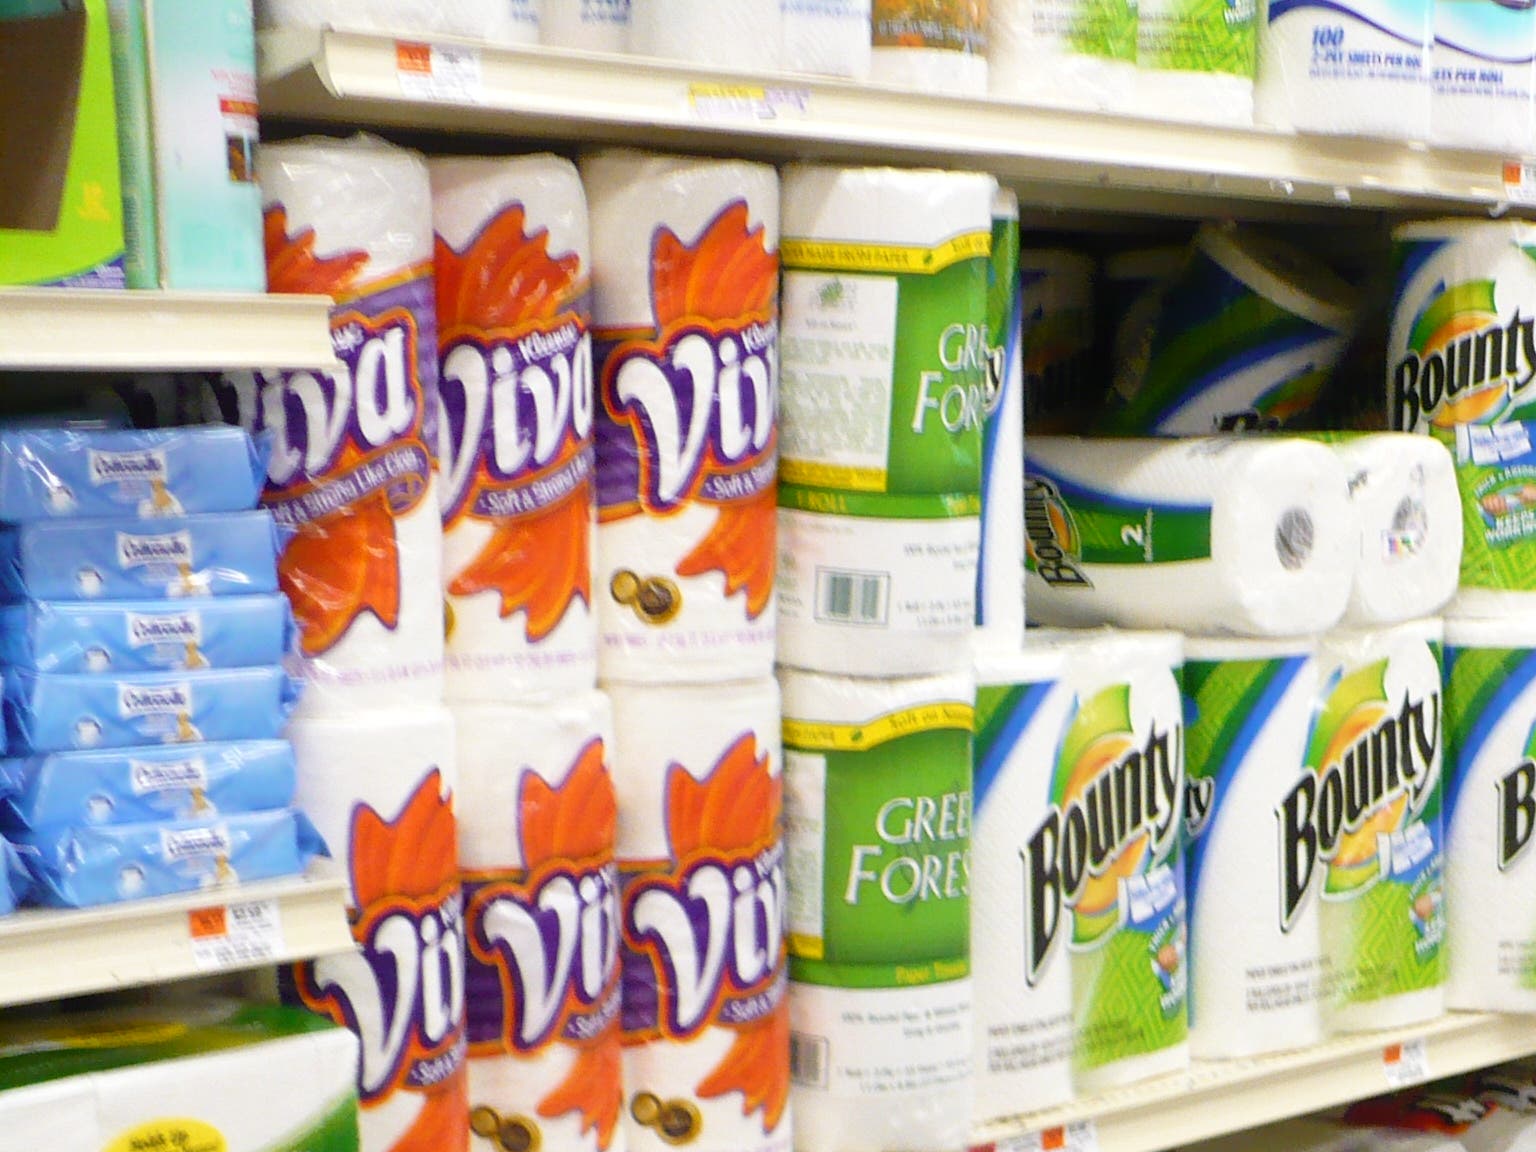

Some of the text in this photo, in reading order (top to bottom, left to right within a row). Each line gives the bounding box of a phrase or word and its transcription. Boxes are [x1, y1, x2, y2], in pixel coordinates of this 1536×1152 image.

[1312, 27, 1345, 47] 100
[1026, 716, 1182, 985] Bounty
[1279, 686, 1439, 930] Bounty
